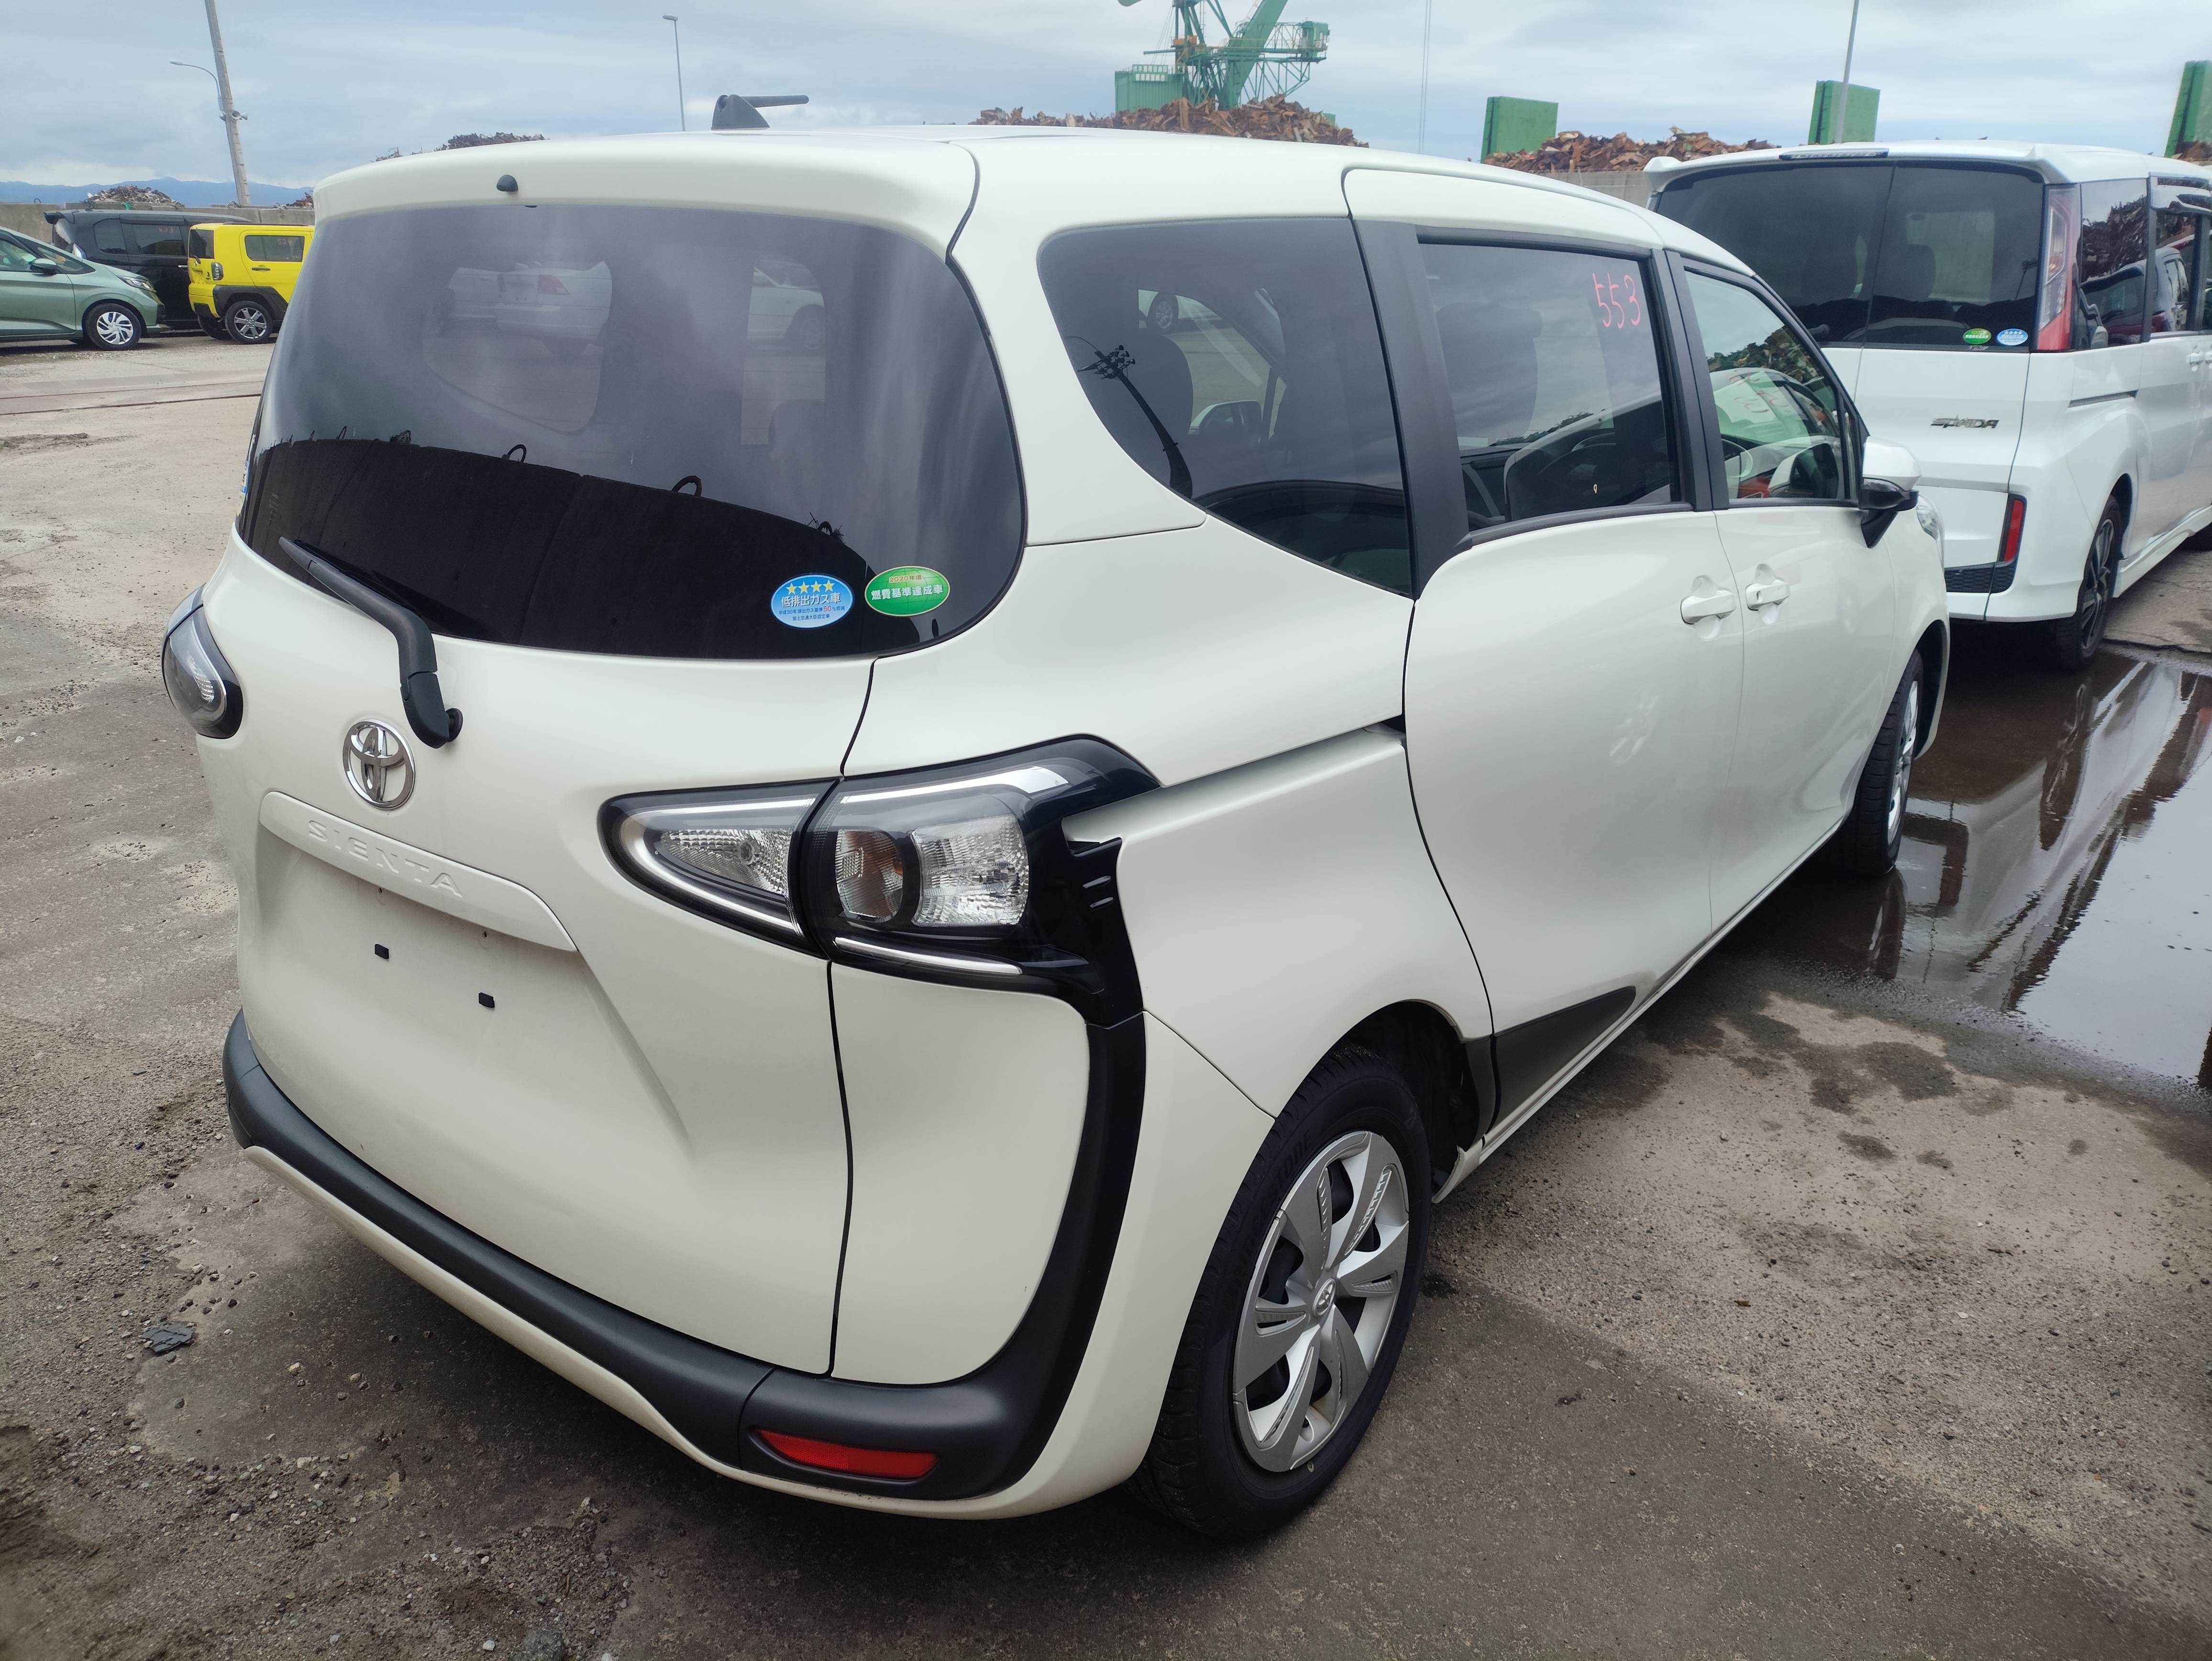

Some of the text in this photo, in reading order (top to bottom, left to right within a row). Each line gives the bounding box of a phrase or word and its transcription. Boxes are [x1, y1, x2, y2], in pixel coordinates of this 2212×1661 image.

[1592, 272, 1641, 329] 553
[781, 592, 841, 608] 低排出ガス車
[871, 584, 943, 600] 燃費基準達成車
[308, 820, 463, 898] SIENTA
